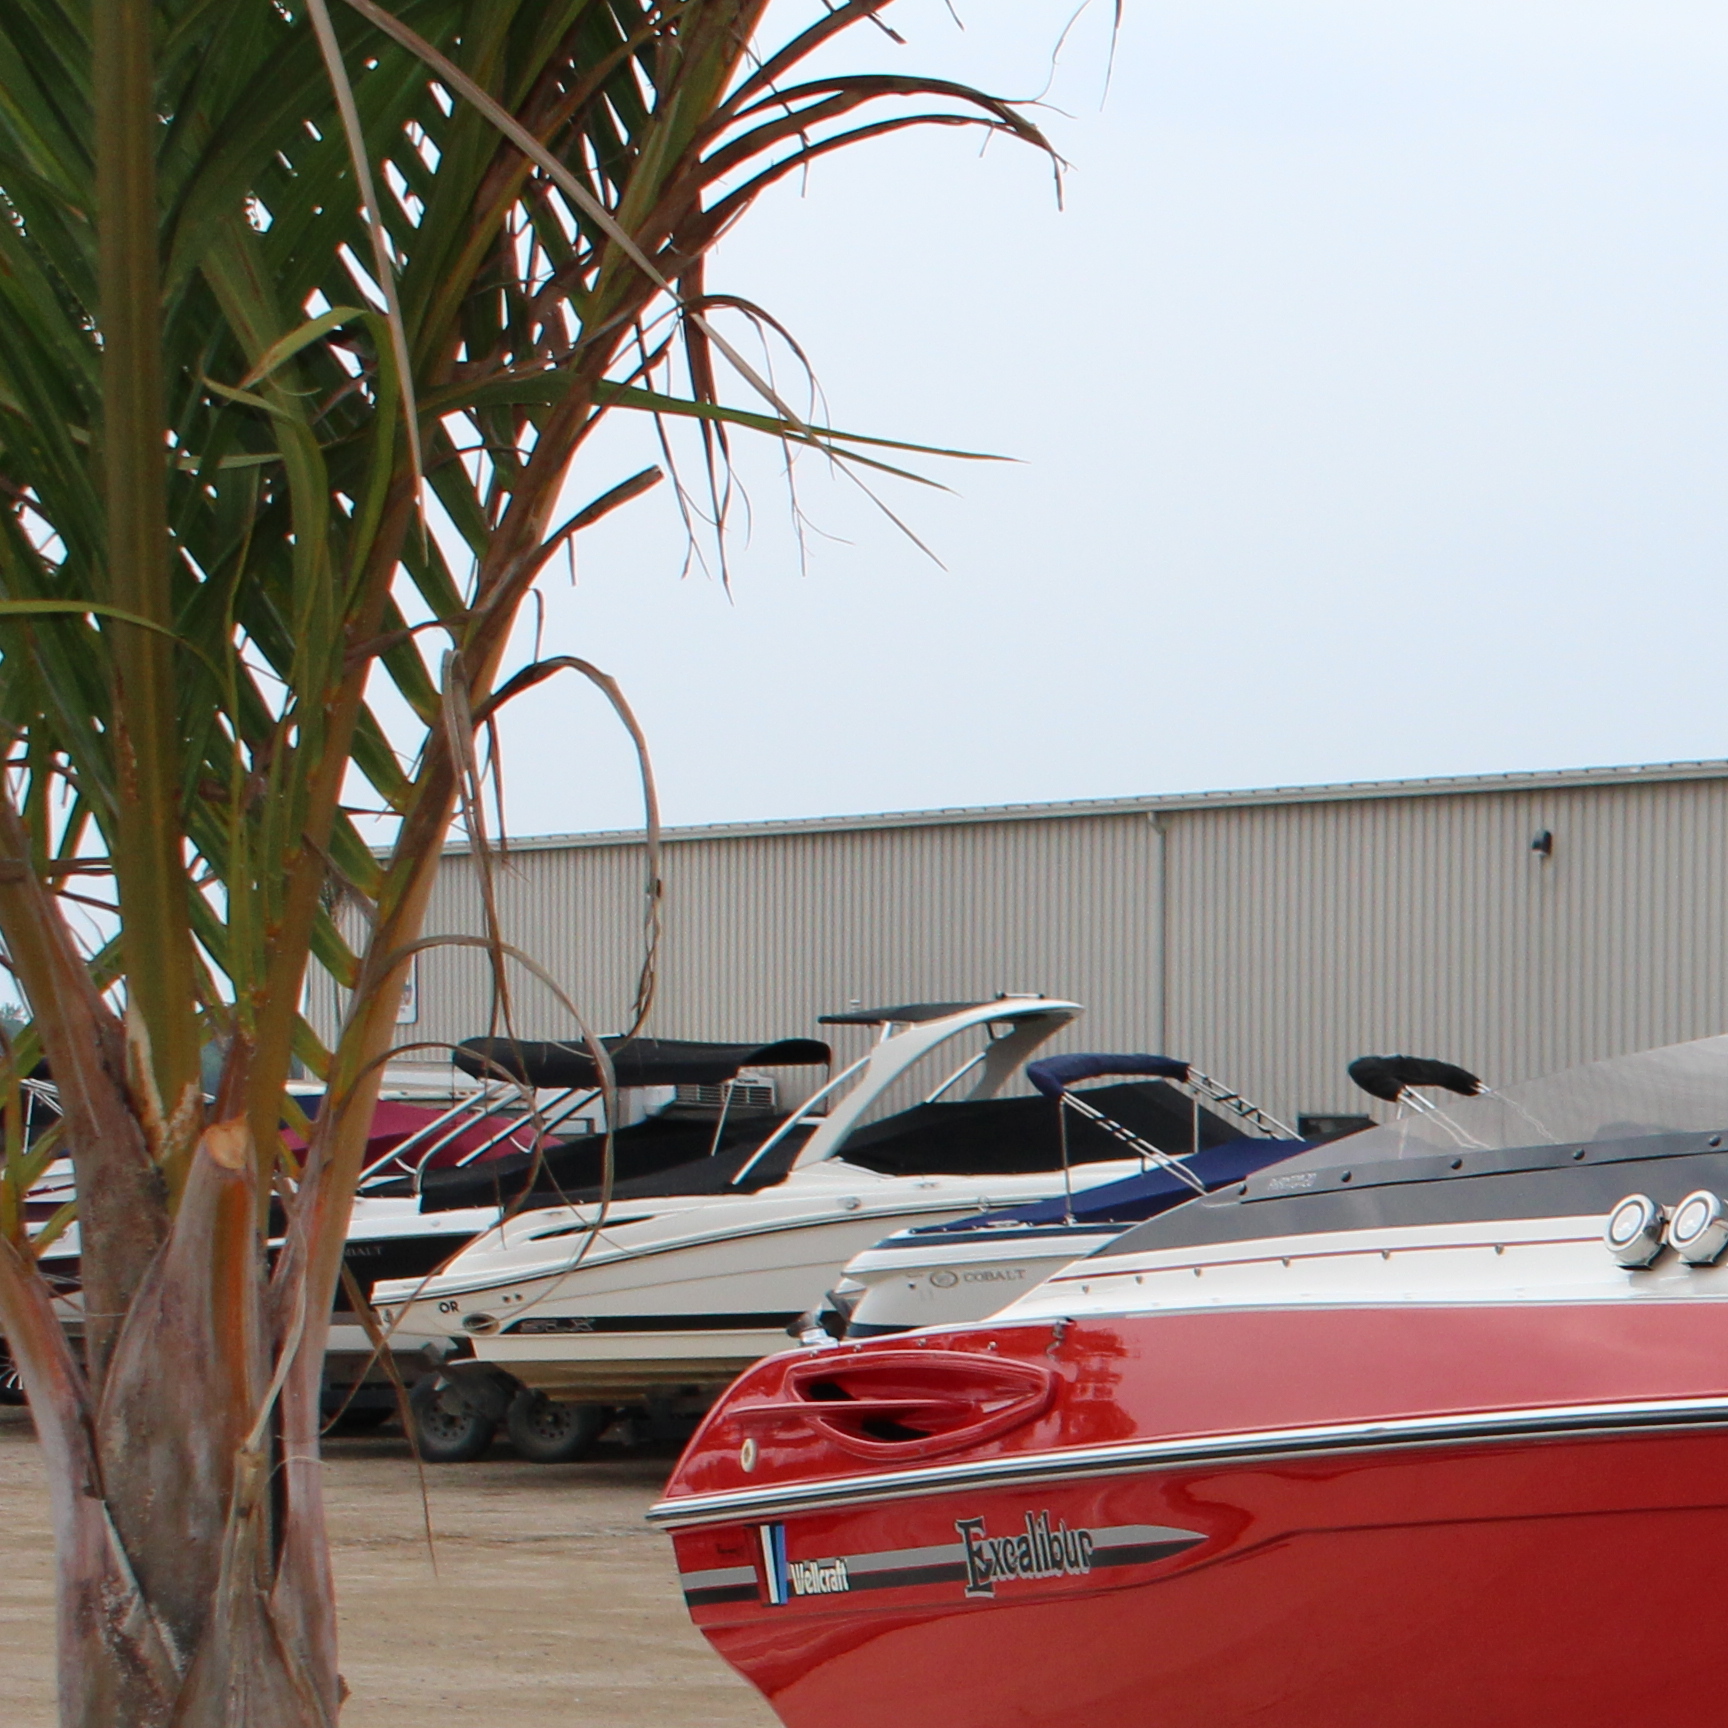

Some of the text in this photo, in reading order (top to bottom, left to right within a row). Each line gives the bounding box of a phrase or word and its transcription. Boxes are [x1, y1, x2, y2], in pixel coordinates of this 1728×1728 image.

[964, 1269, 1025, 1282] COBALT
[954, 1509, 1093, 1598] Excalibur
[789, 1559, 849, 1595] Wellcraft
